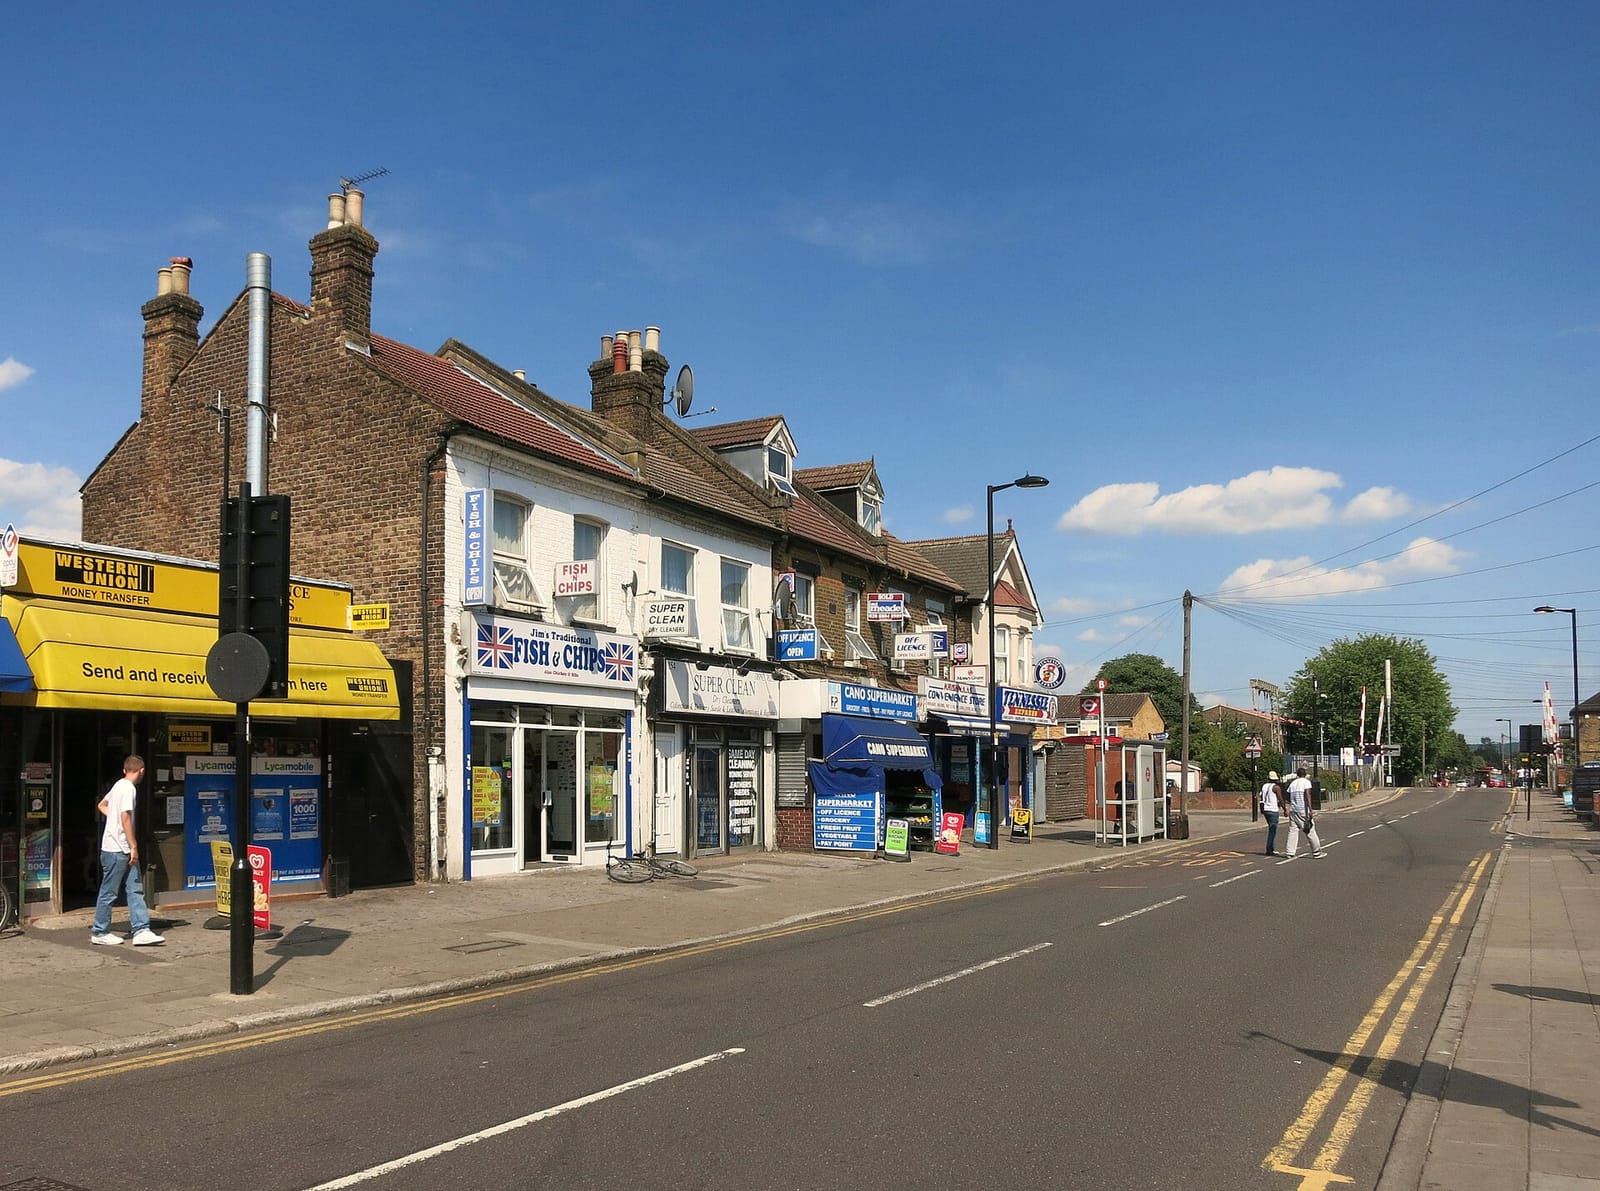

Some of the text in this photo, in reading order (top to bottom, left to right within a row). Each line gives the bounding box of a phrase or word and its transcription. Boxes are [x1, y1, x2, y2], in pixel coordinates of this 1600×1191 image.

[468, 494, 480, 528] FISH
[56, 553, 139, 576] WESTERN
[468, 542, 480, 584] CHIPS
[562, 564, 588, 575] FISH
[83, 572, 138, 590] UNION
[558, 581, 592, 593] CHIPS
[62, 586, 150, 605] MONEY TRANSFER
[289, 585, 310, 599] CE
[649, 604, 685, 613] SUPER
[649, 616, 685, 624] CLEAN
[552, 632, 591, 645] Traditional
[778, 632, 814, 643] OFF LICENCE
[514, 637, 606, 673] FISH & CHIPS
[787, 647, 803, 656] OPEN
[82, 662, 206, 685] Send and receiv
[300, 678, 328, 691] here
[694, 674, 755, 696] SUPER CLEAN
[1099, 680, 1105, 688] B
[844, 686, 914, 706] CANO SUPERMARKET
[928, 690, 986, 706] CONVENIENCE STORE
[1004, 690, 1049, 711] TENNESSEE
[745, 749, 755, 759] DAY
[867, 742, 928, 757] CANO SUPERMARKET
[195, 760, 236, 771] Lycamob
[265, 762, 314, 772] Lycamobile
[729, 760, 755, 769] CLEANING
[293, 804, 315, 814] 1000
[817, 799, 872, 808] SUPERMARKET
